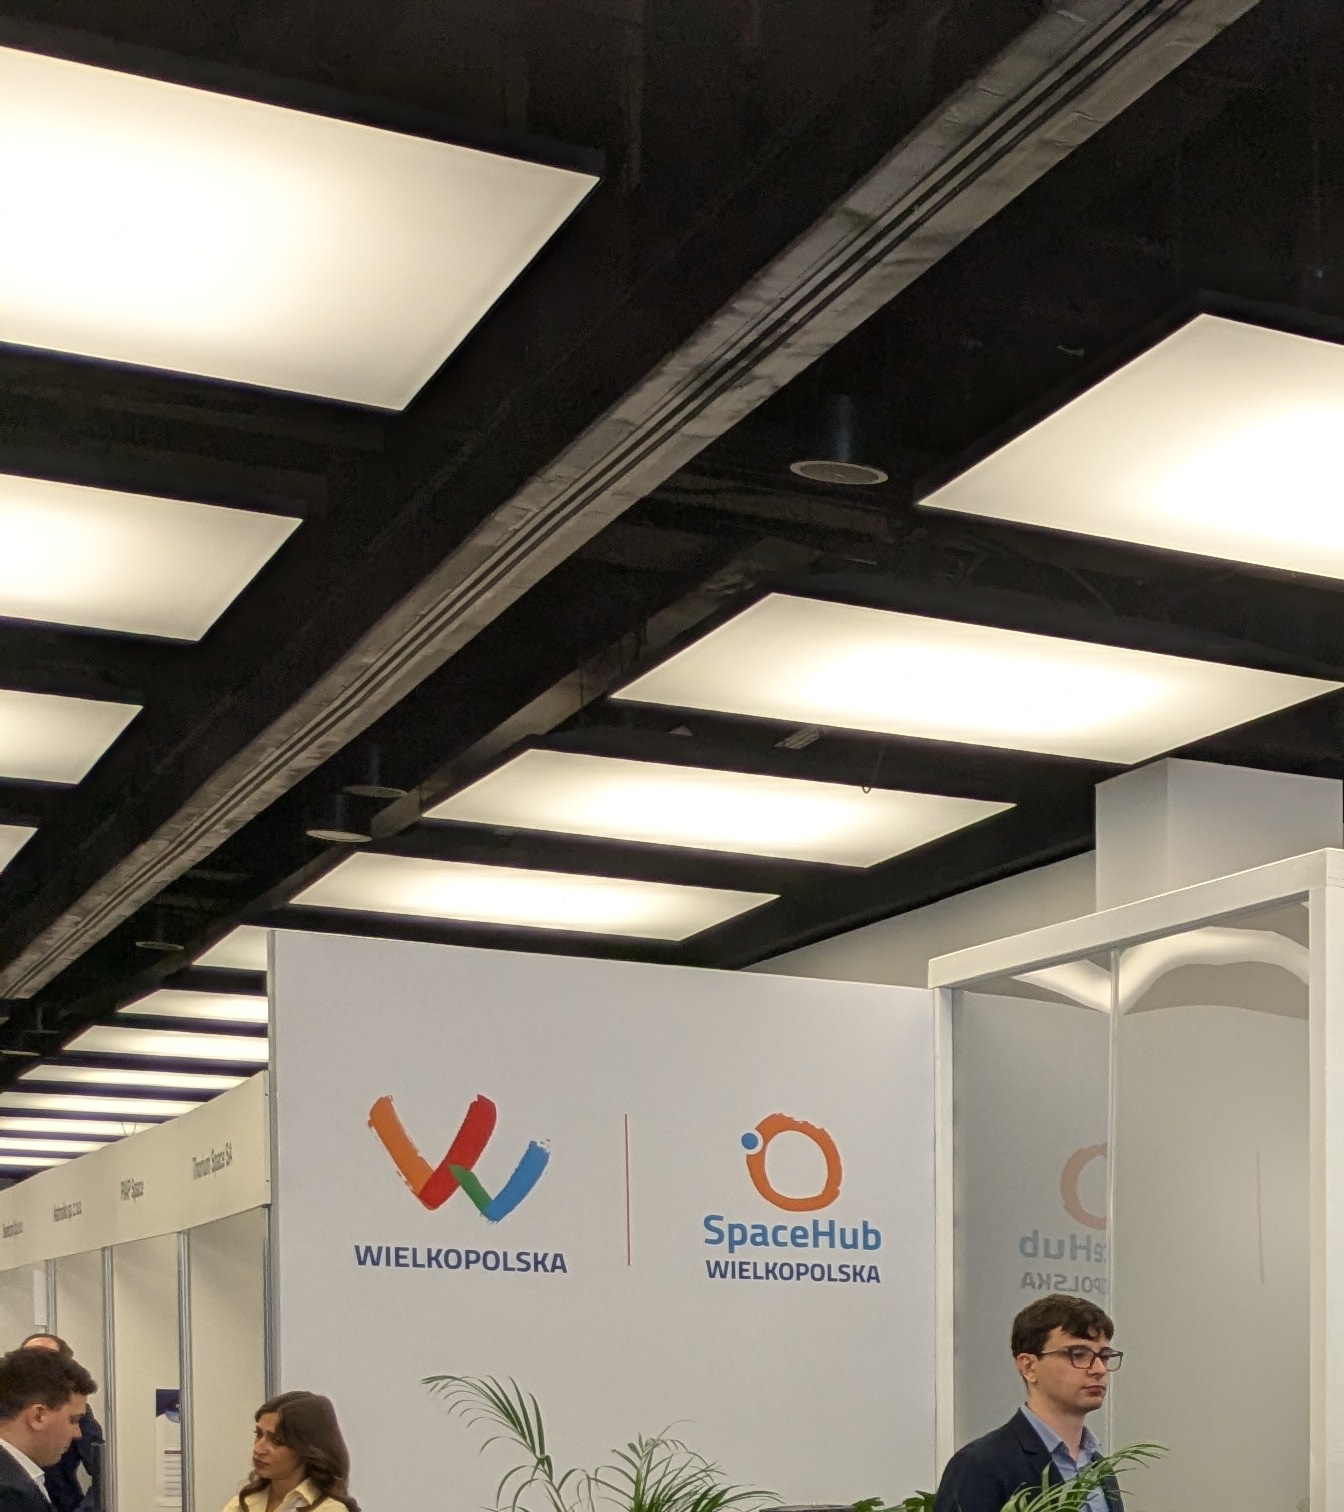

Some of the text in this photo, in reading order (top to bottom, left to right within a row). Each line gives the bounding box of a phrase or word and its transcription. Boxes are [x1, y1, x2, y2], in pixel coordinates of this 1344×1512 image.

[703, 1214, 882, 1254] SpaceHub
[354, 1244, 567, 1273] WIELKOPOLSKA
[706, 1260, 881, 1283] WIELKOPOLSKA
